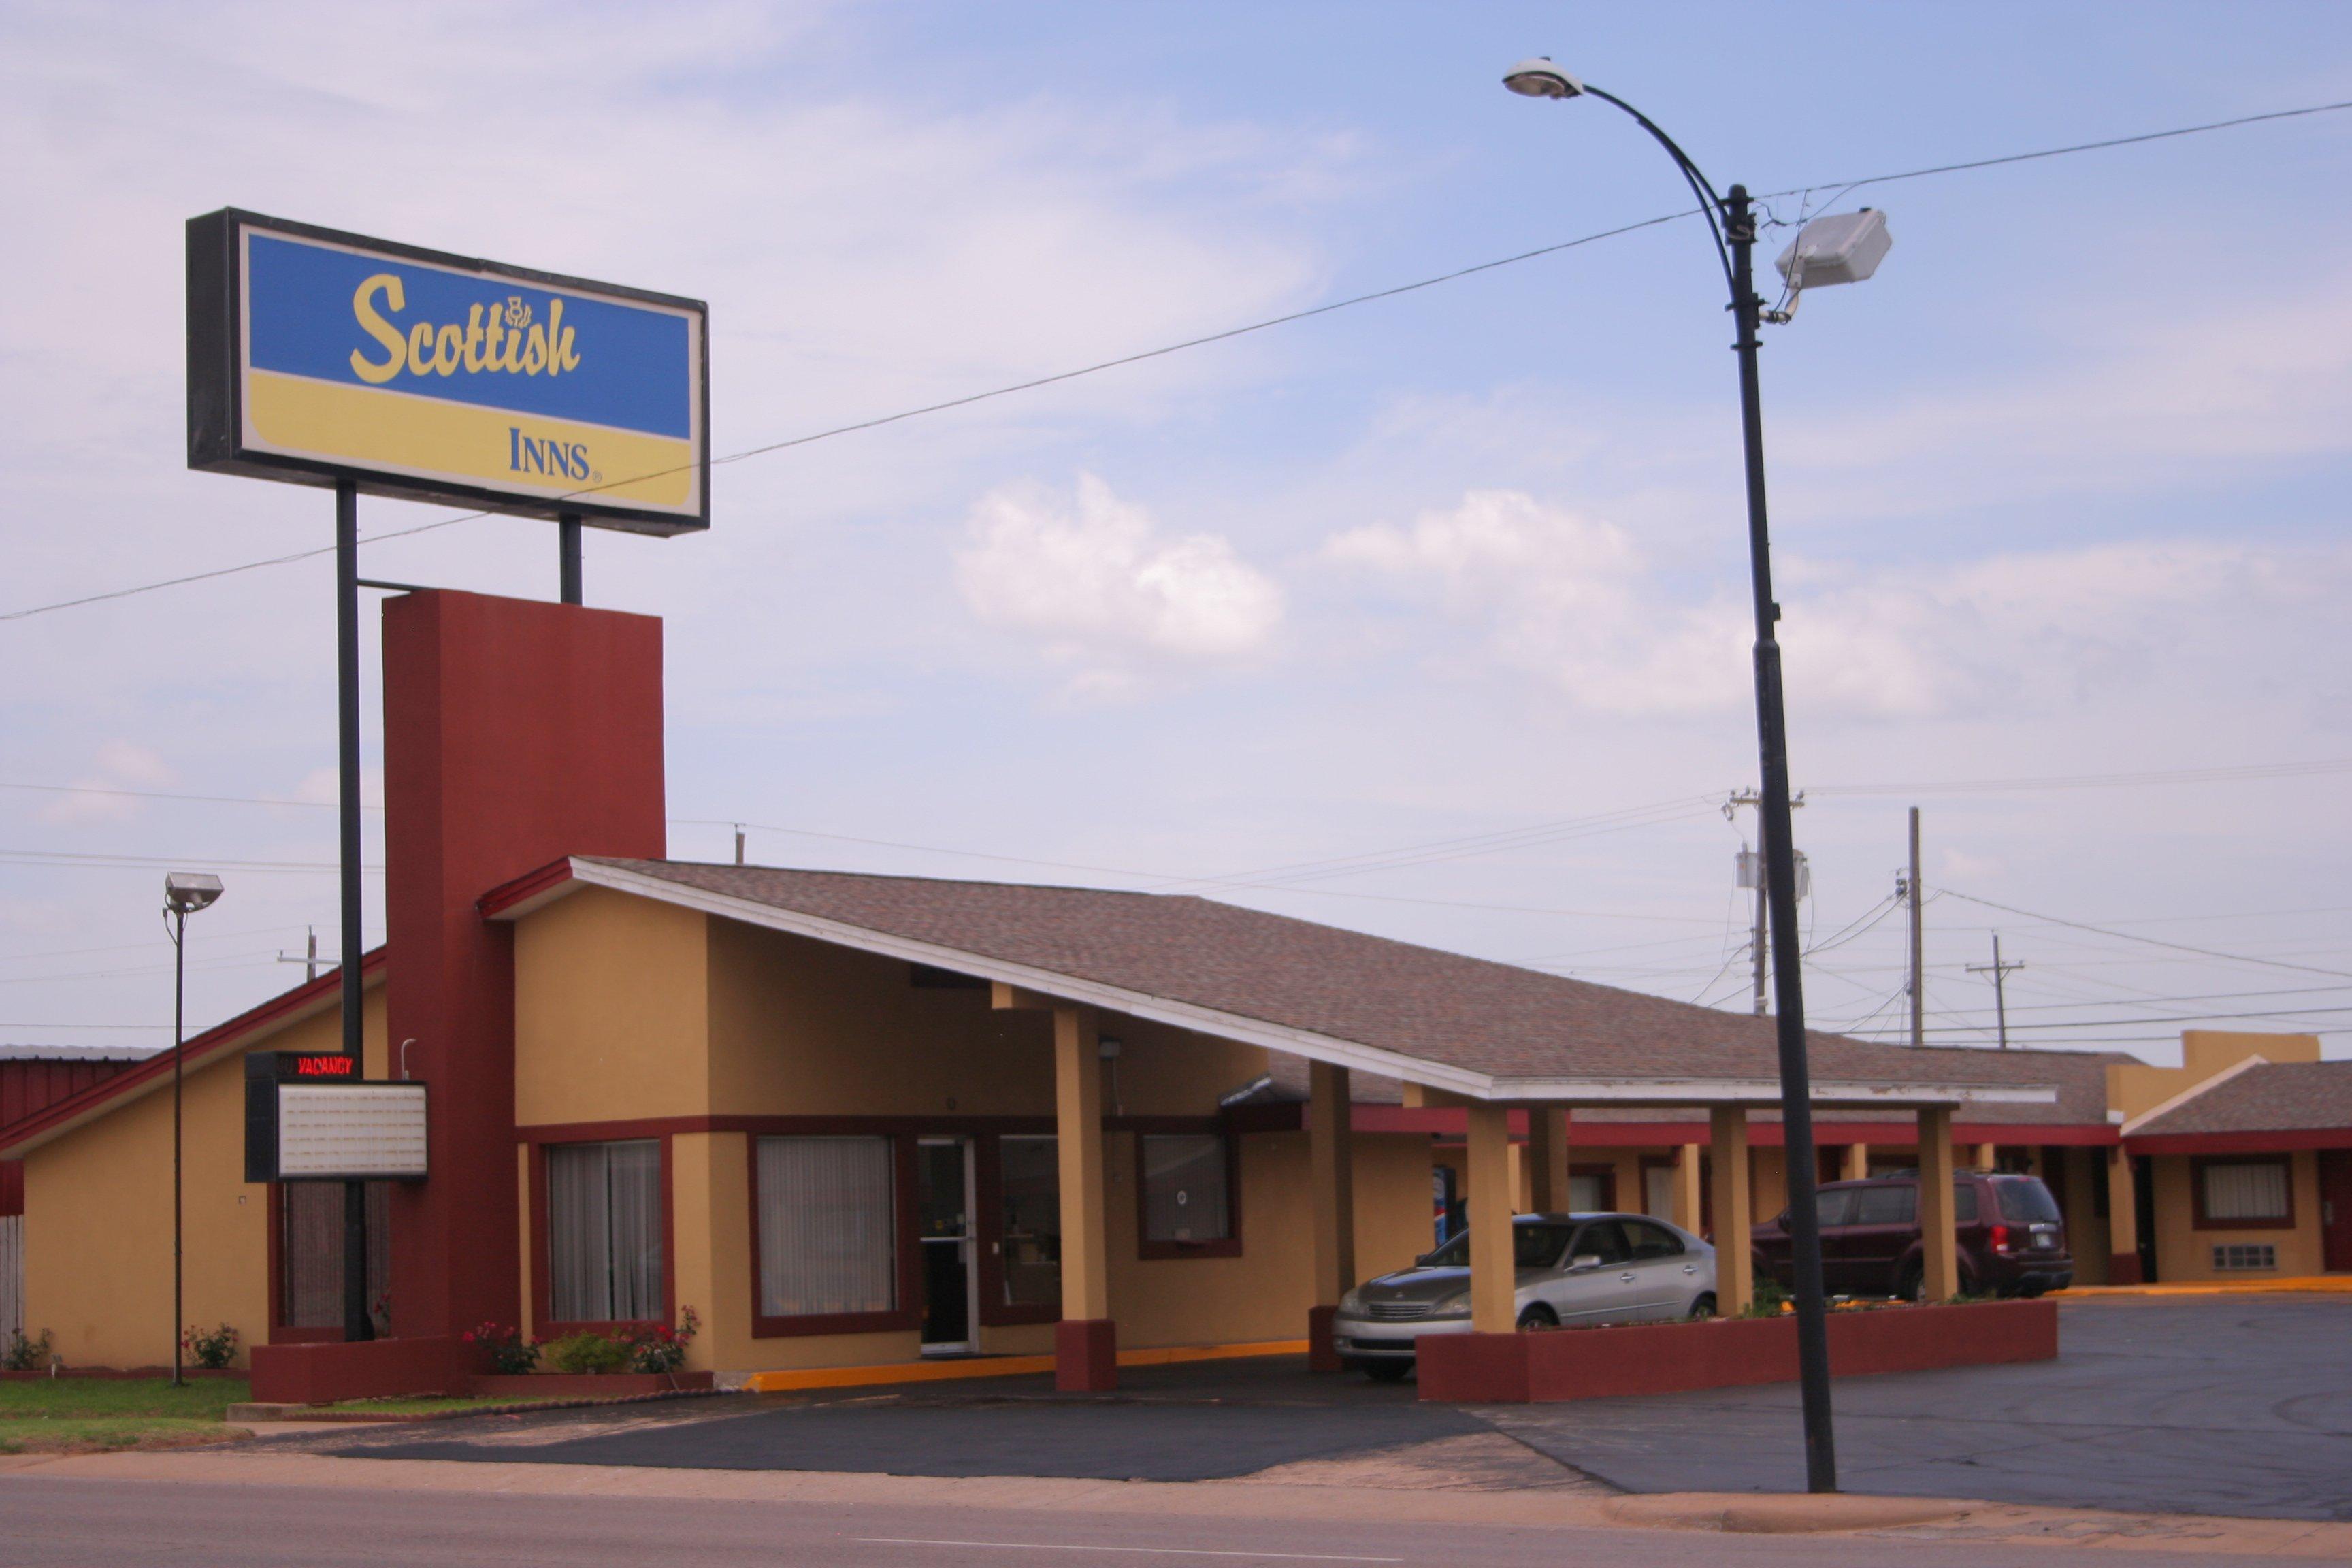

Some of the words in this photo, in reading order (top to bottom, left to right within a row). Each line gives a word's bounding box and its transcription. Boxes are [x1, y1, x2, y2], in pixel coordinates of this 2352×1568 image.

[350, 274, 580, 384] Scottish
[509, 427, 589, 480] INNS
[297, 1056, 353, 1075] VACANCY
